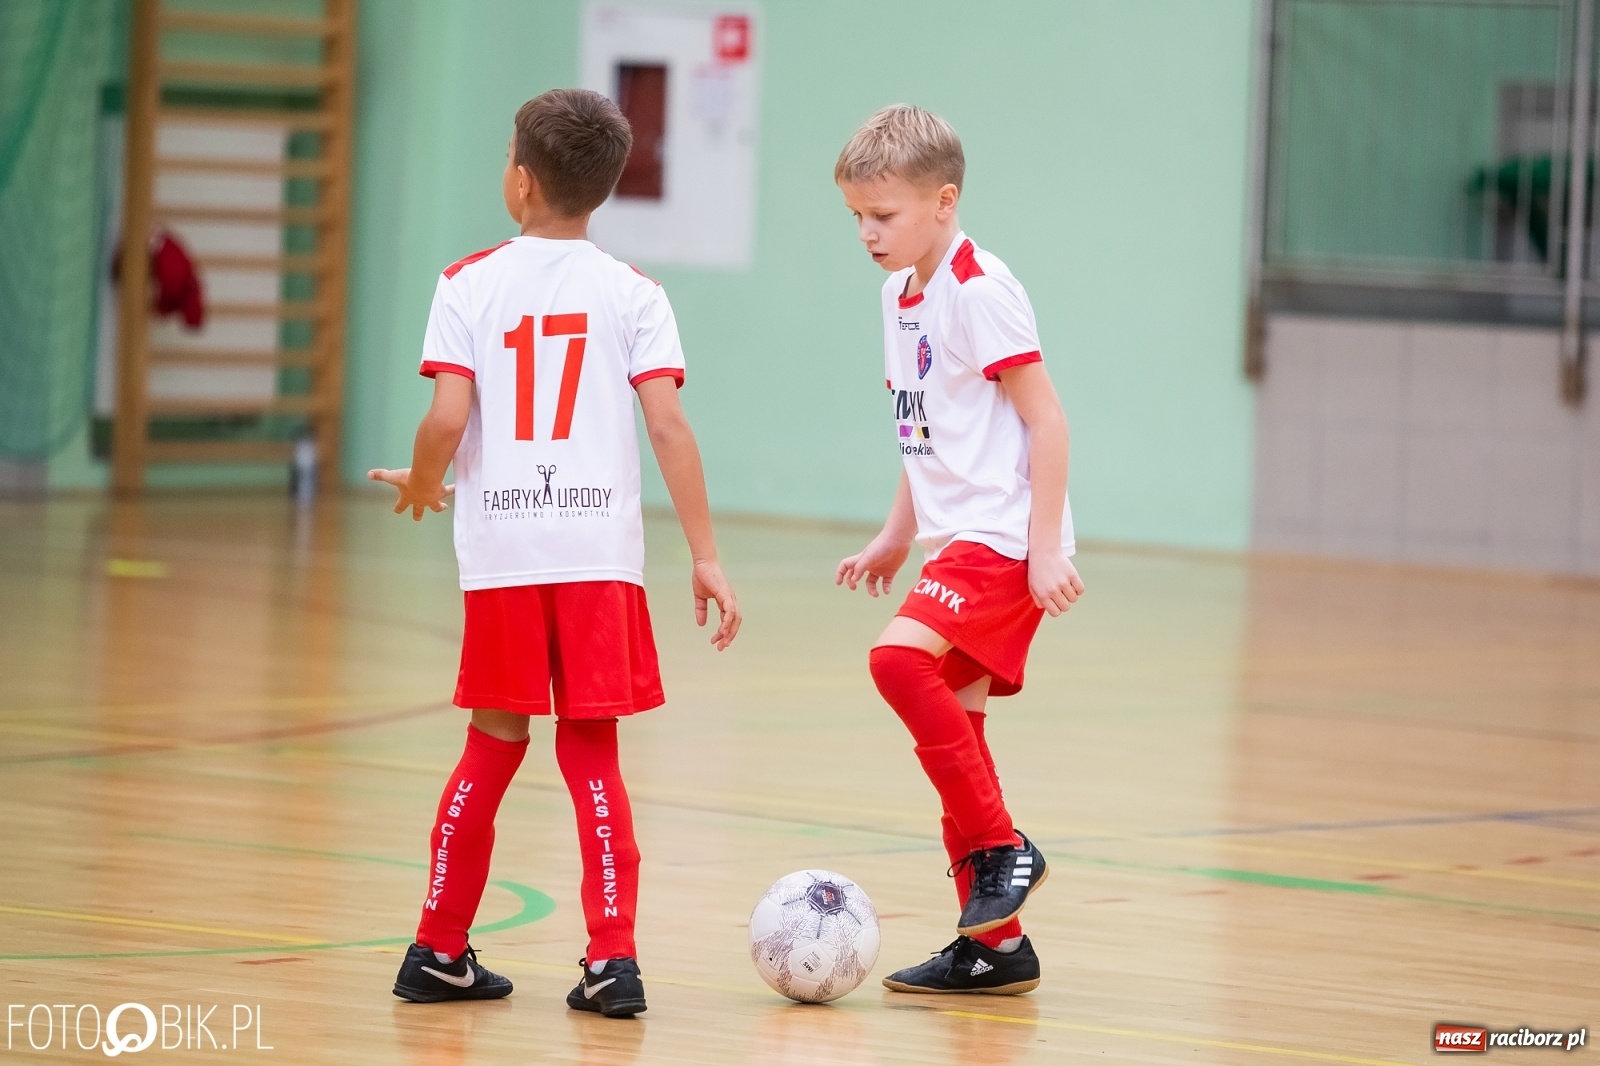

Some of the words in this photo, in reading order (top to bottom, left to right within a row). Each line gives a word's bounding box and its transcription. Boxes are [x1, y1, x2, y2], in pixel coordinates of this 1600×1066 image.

[504, 312, 588, 441] 17
[483, 484, 554, 511] FABRYKA
[558, 487, 612, 509] URODY
[559, 510, 610, 518] KOSMETYKA
[913, 578, 967, 615] CMYK
[447, 779, 473, 818] UKS
[588, 779, 610, 818] UKS
[425, 822, 456, 911] CIESZYN
[595, 825, 618, 918] CIESZYN
